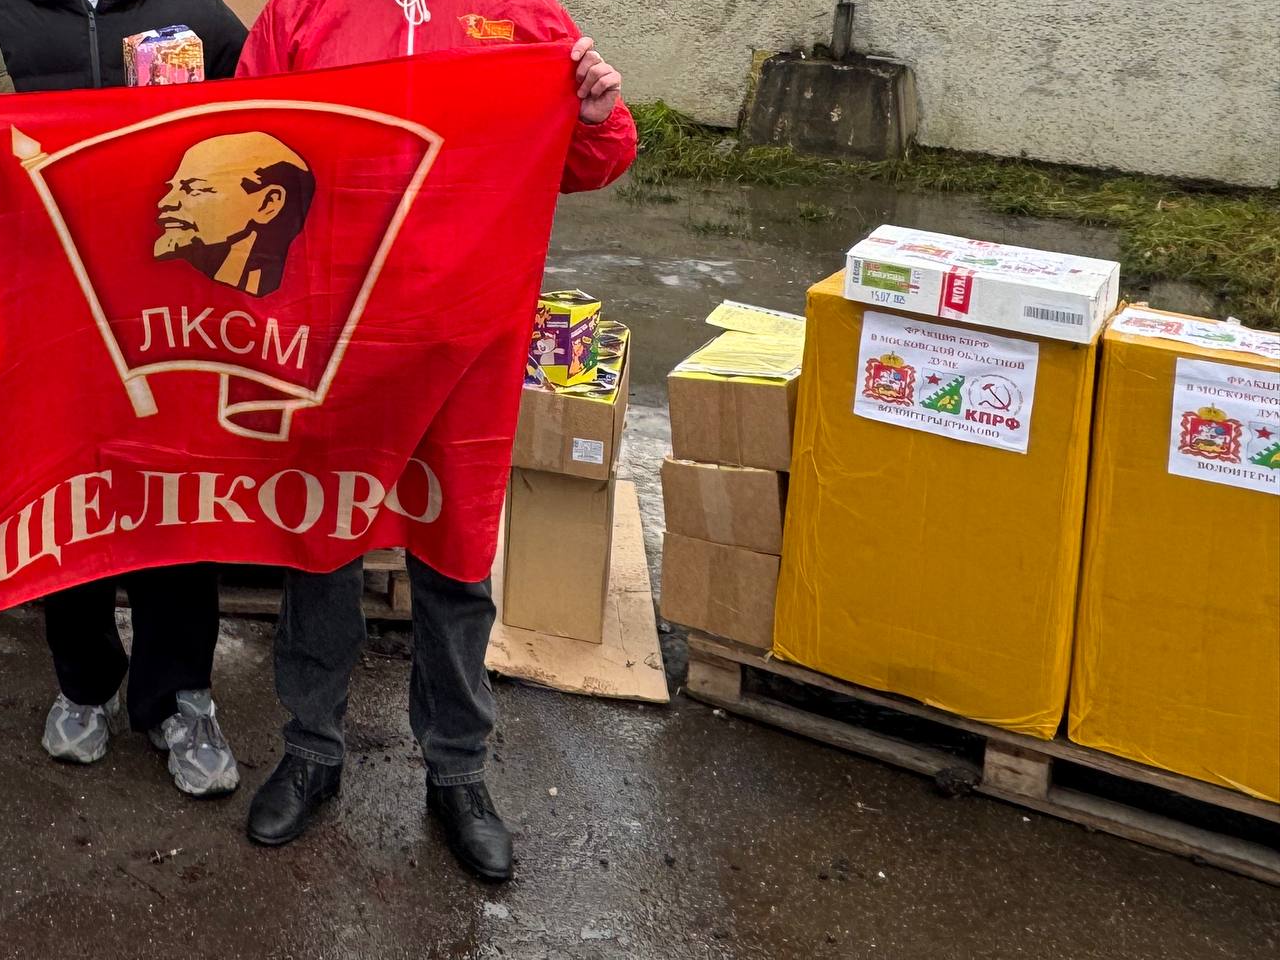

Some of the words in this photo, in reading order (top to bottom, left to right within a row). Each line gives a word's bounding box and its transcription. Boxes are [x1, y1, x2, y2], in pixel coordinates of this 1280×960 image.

[140, 306, 310, 370] ЛКСМ
[1197, 385, 1280, 406] МОСКОВСКО
[965, 408, 1021, 431] КПРФ
